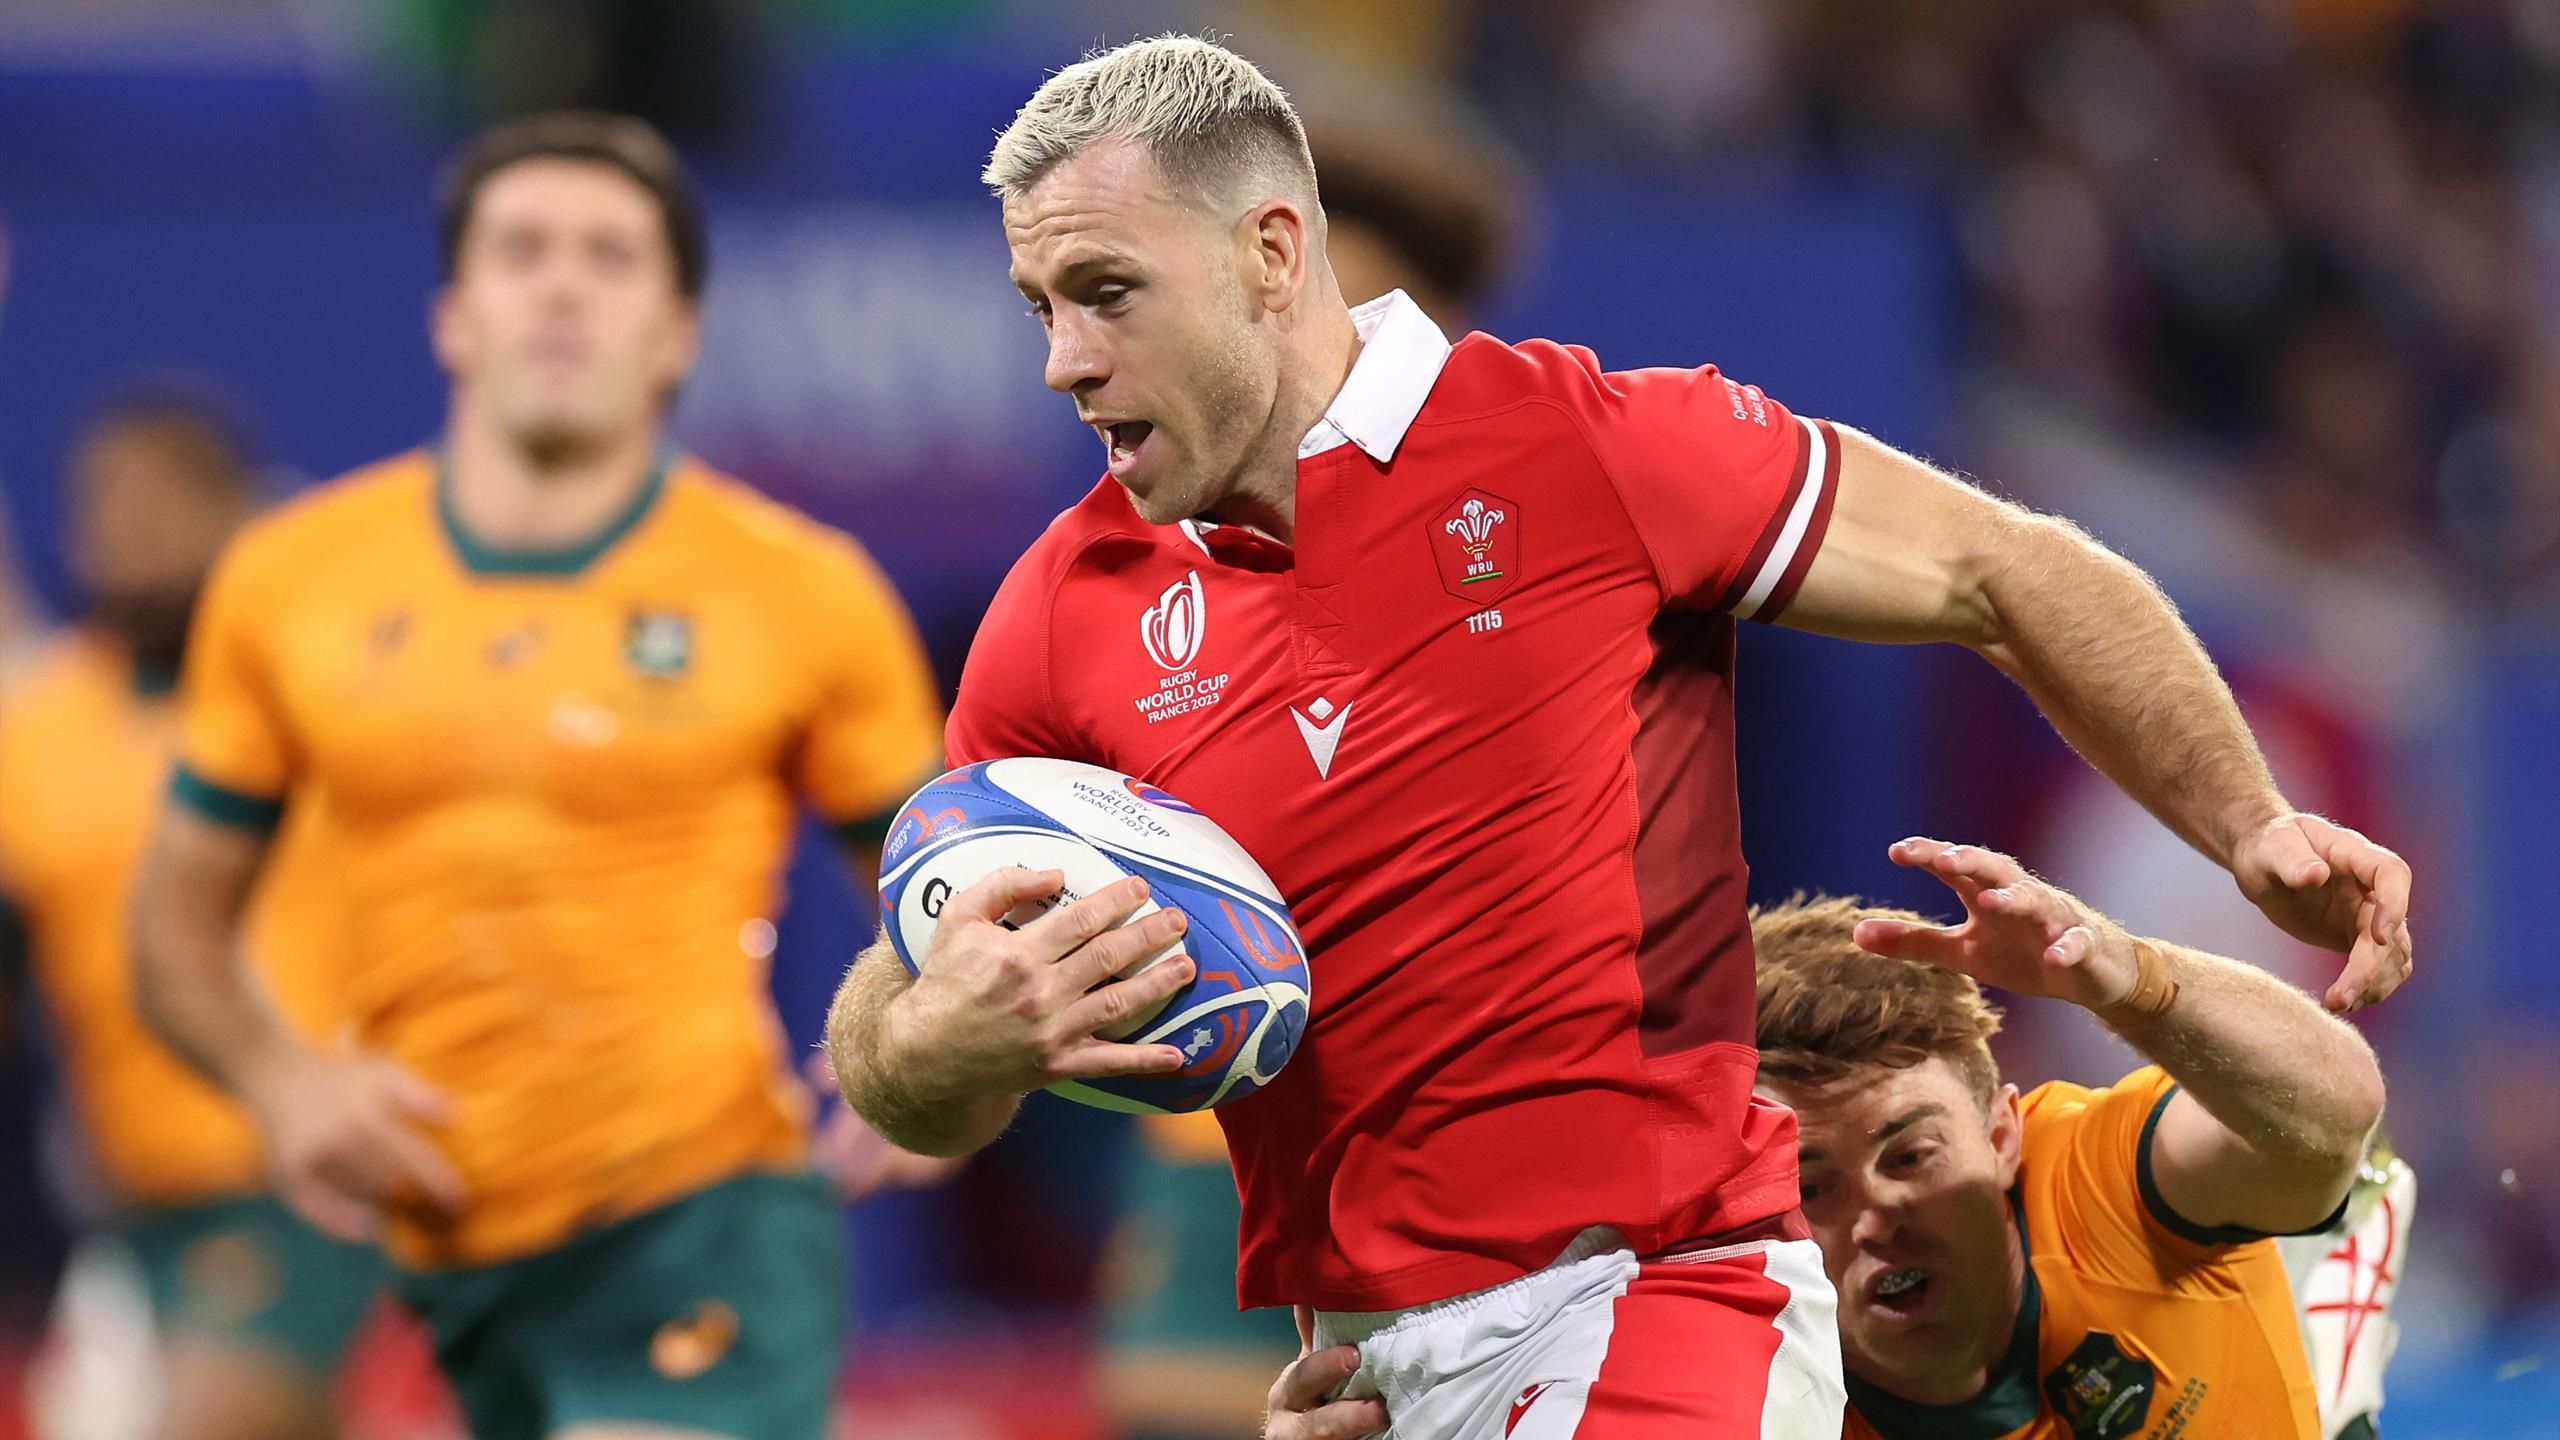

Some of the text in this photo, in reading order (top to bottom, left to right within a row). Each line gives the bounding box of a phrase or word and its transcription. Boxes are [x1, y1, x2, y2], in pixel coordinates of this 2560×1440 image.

[1467, 560, 1494, 576] WRU
[1465, 610, 1503, 634] 1115
[1134, 673, 1229, 713] WORLD CUP
[1159, 669, 1198, 690] RUGBY
[1147, 692, 1221, 724] FRANCE 2023
[1073, 781, 1170, 838] WORLD CUP
[1110, 789, 1152, 812] RUGBY
[1072, 792, 1150, 838] FRANCE 2023
